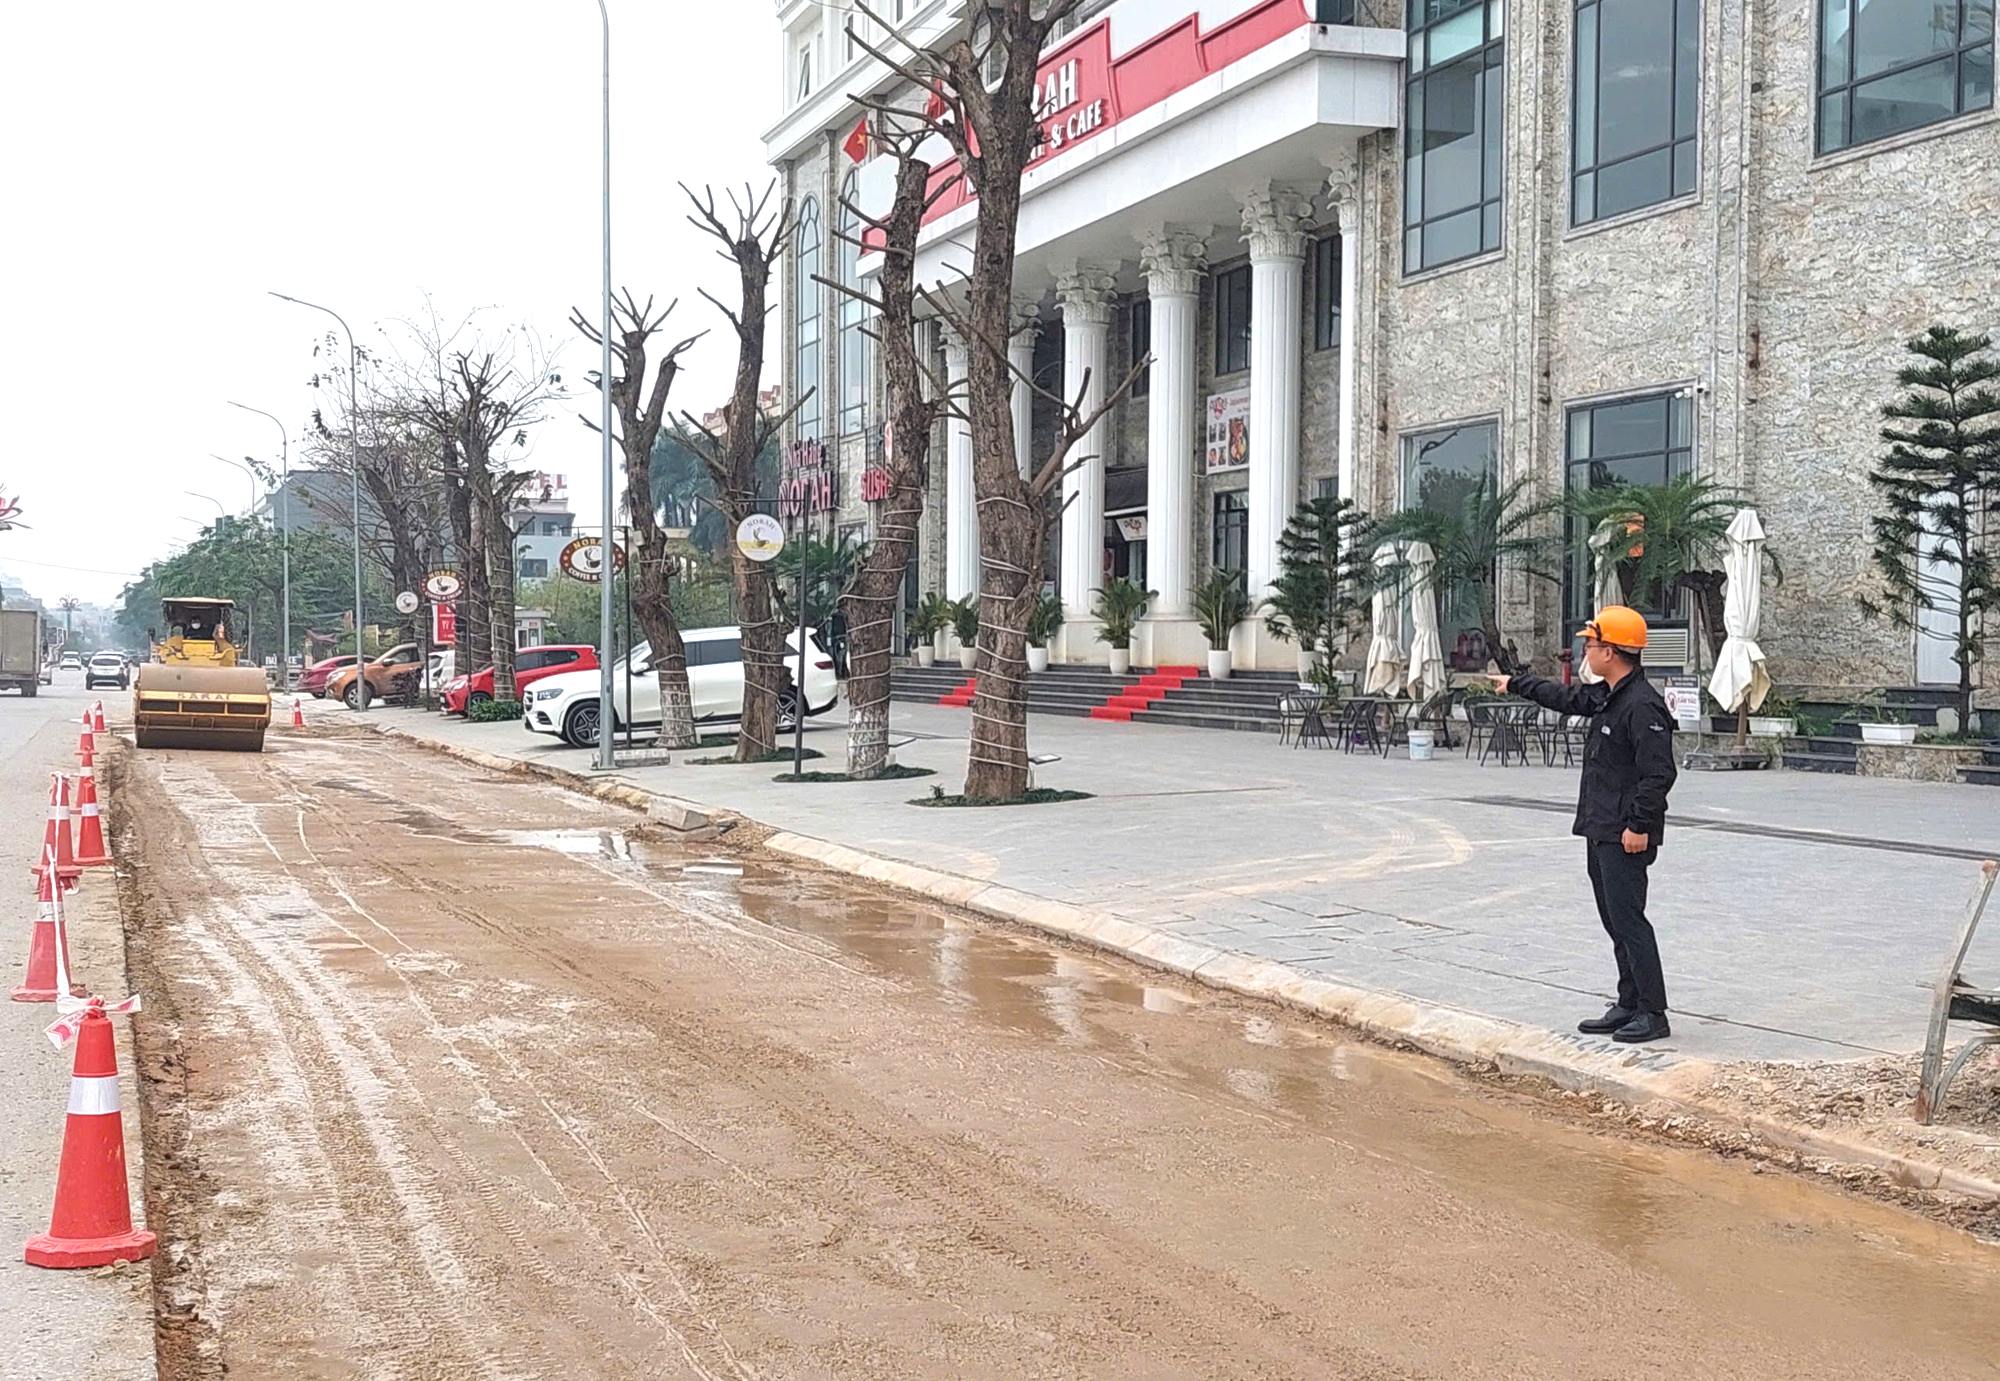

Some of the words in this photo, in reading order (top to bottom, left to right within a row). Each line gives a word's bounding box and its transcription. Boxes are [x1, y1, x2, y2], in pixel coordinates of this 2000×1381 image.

[1050, 123, 1064, 150] &
[1066, 98, 1102, 140] CAFE
[177, 692, 230, 701] SAKAI
